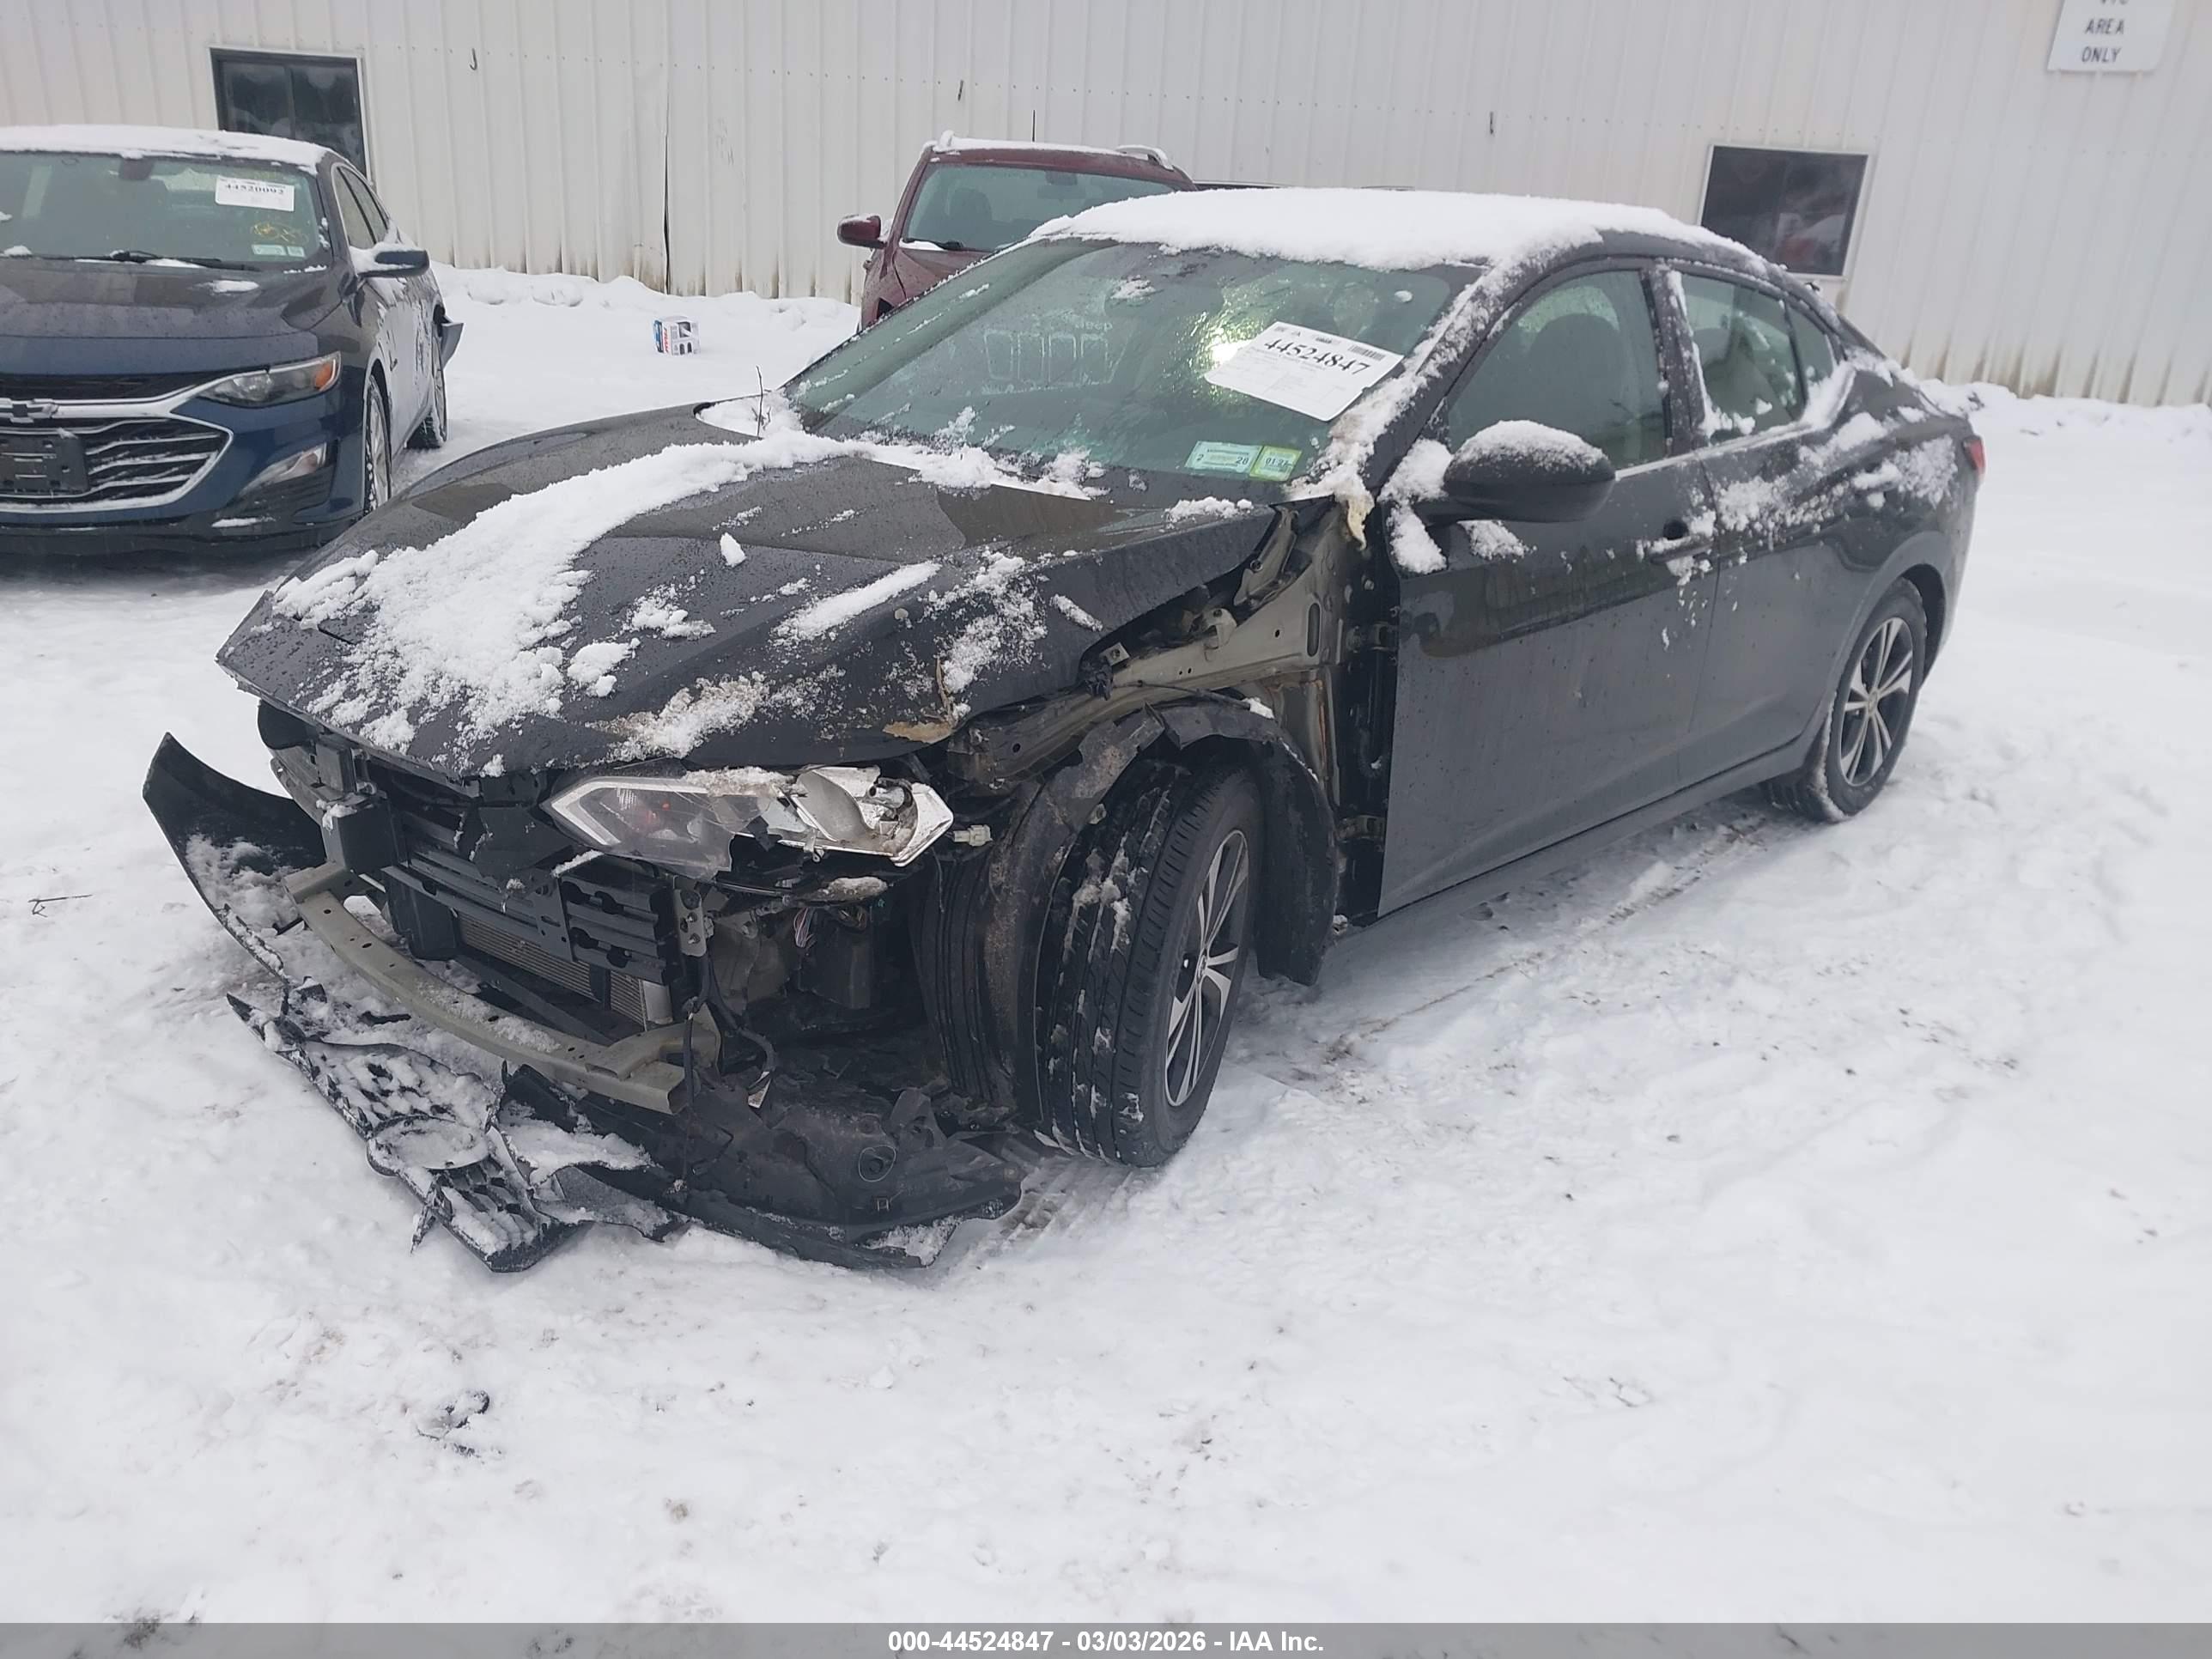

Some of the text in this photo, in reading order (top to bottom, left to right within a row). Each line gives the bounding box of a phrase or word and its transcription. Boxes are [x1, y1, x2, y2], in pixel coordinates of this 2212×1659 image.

[2085, 18, 2124, 34] AREA
[2081, 46, 2121, 63] ONLY
[1264, 338, 1371, 375] 44524847
